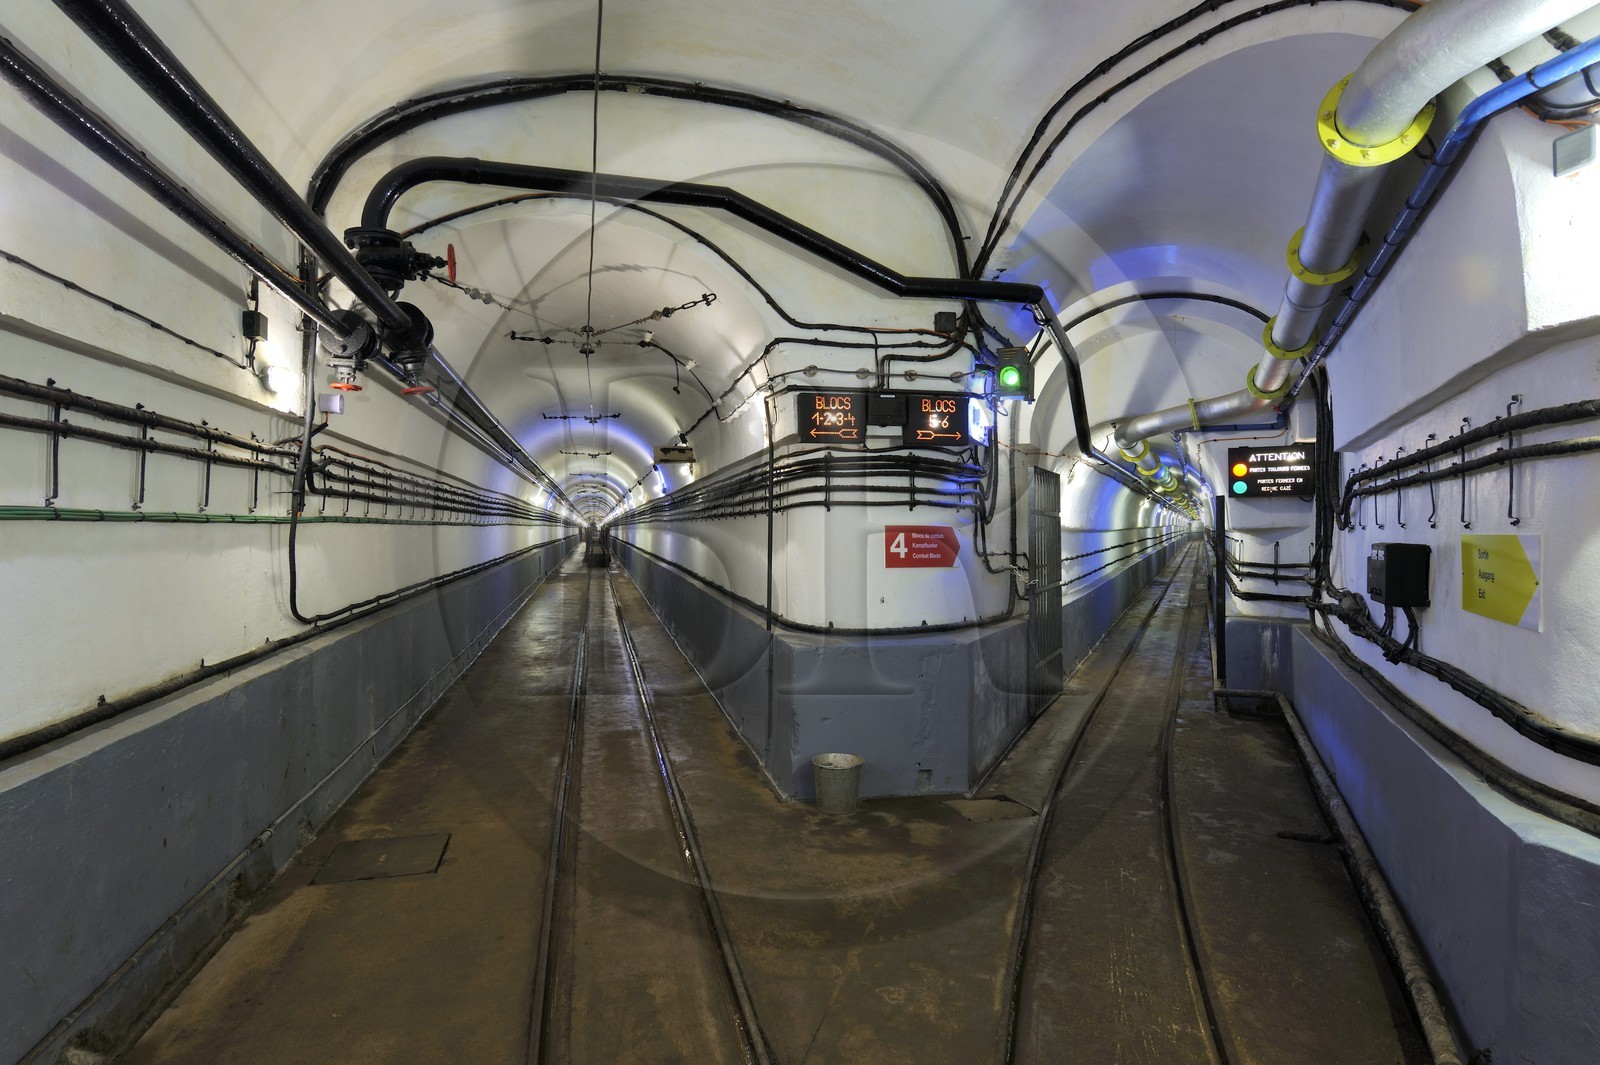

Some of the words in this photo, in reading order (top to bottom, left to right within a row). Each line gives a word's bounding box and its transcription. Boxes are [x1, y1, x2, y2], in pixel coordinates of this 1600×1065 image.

[815, 396, 851, 410] BLOCS
[921, 399, 956, 413] BLOCS
[928, 414, 950, 428] 5-6
[1249, 451, 1306, 462] ATTENTION
[890, 533, 908, 559] 4
[1478, 549, 1489, 560] Sortie
[1478, 569, 1495, 583] Ausgang
[1478, 588, 1486, 599] Exit
